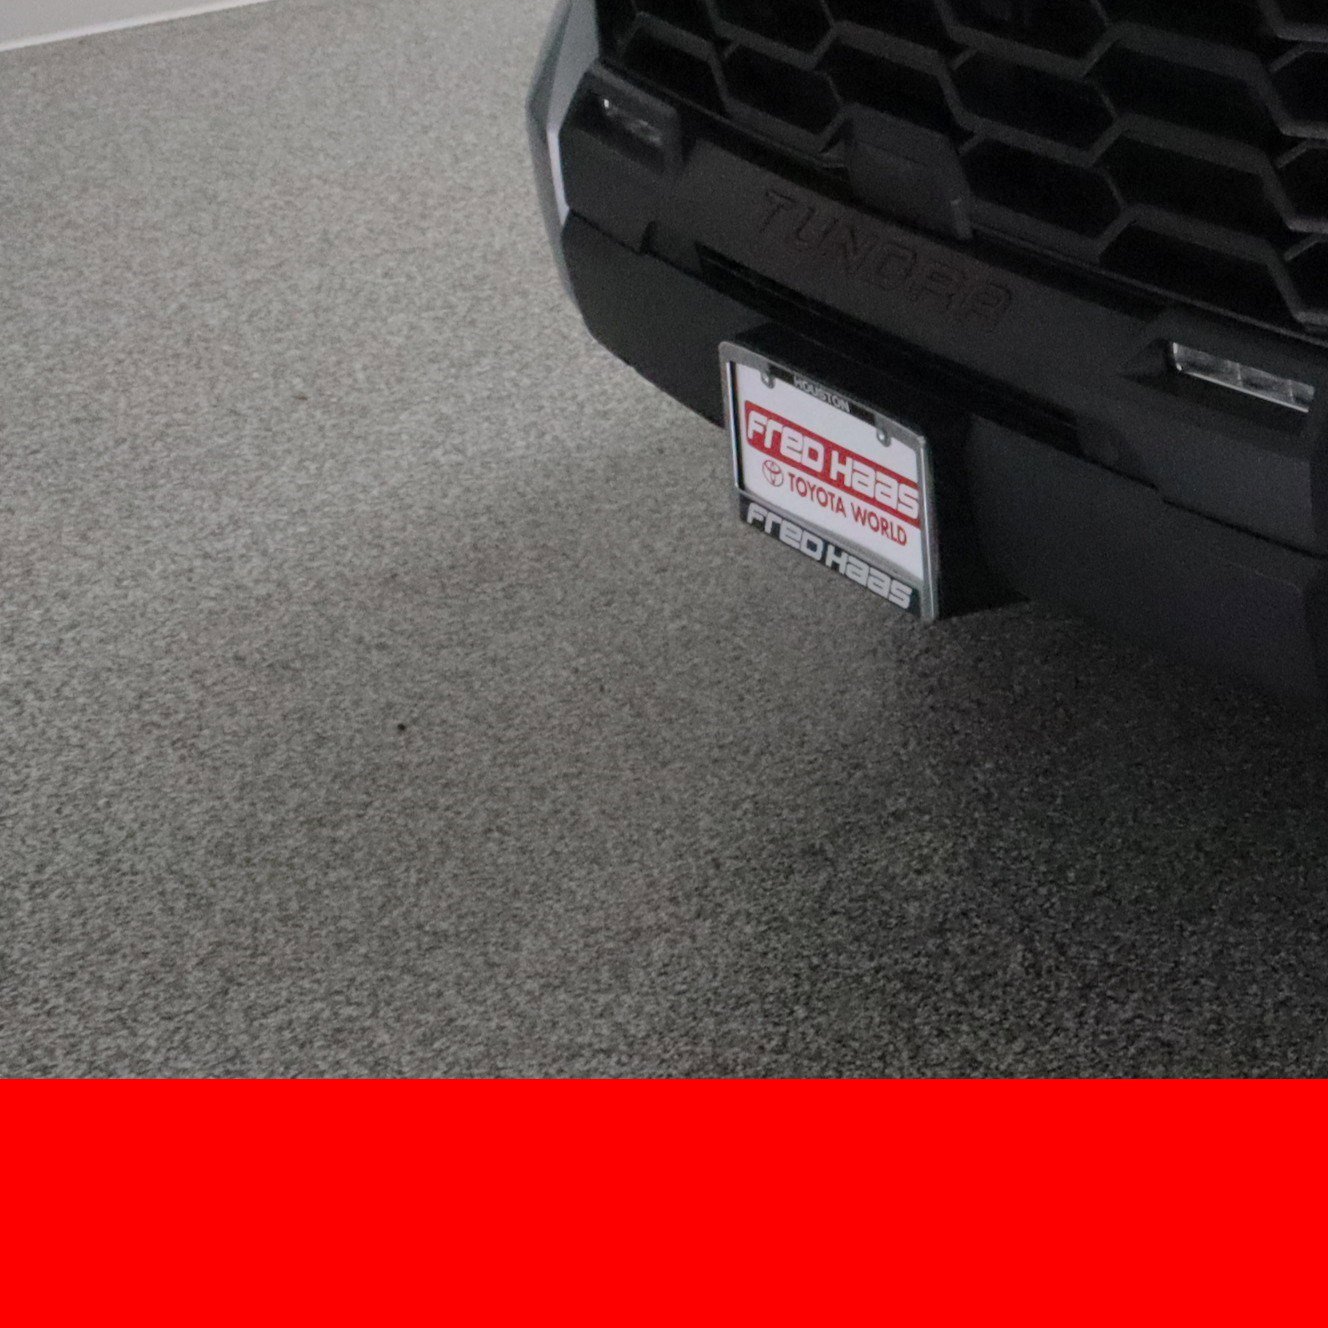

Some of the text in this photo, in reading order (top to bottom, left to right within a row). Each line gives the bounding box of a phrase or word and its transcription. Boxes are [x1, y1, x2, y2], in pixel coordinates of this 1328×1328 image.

[759, 188, 1014, 329] TUNDRA
[788, 472, 907, 547] TOYOTA WORLD
